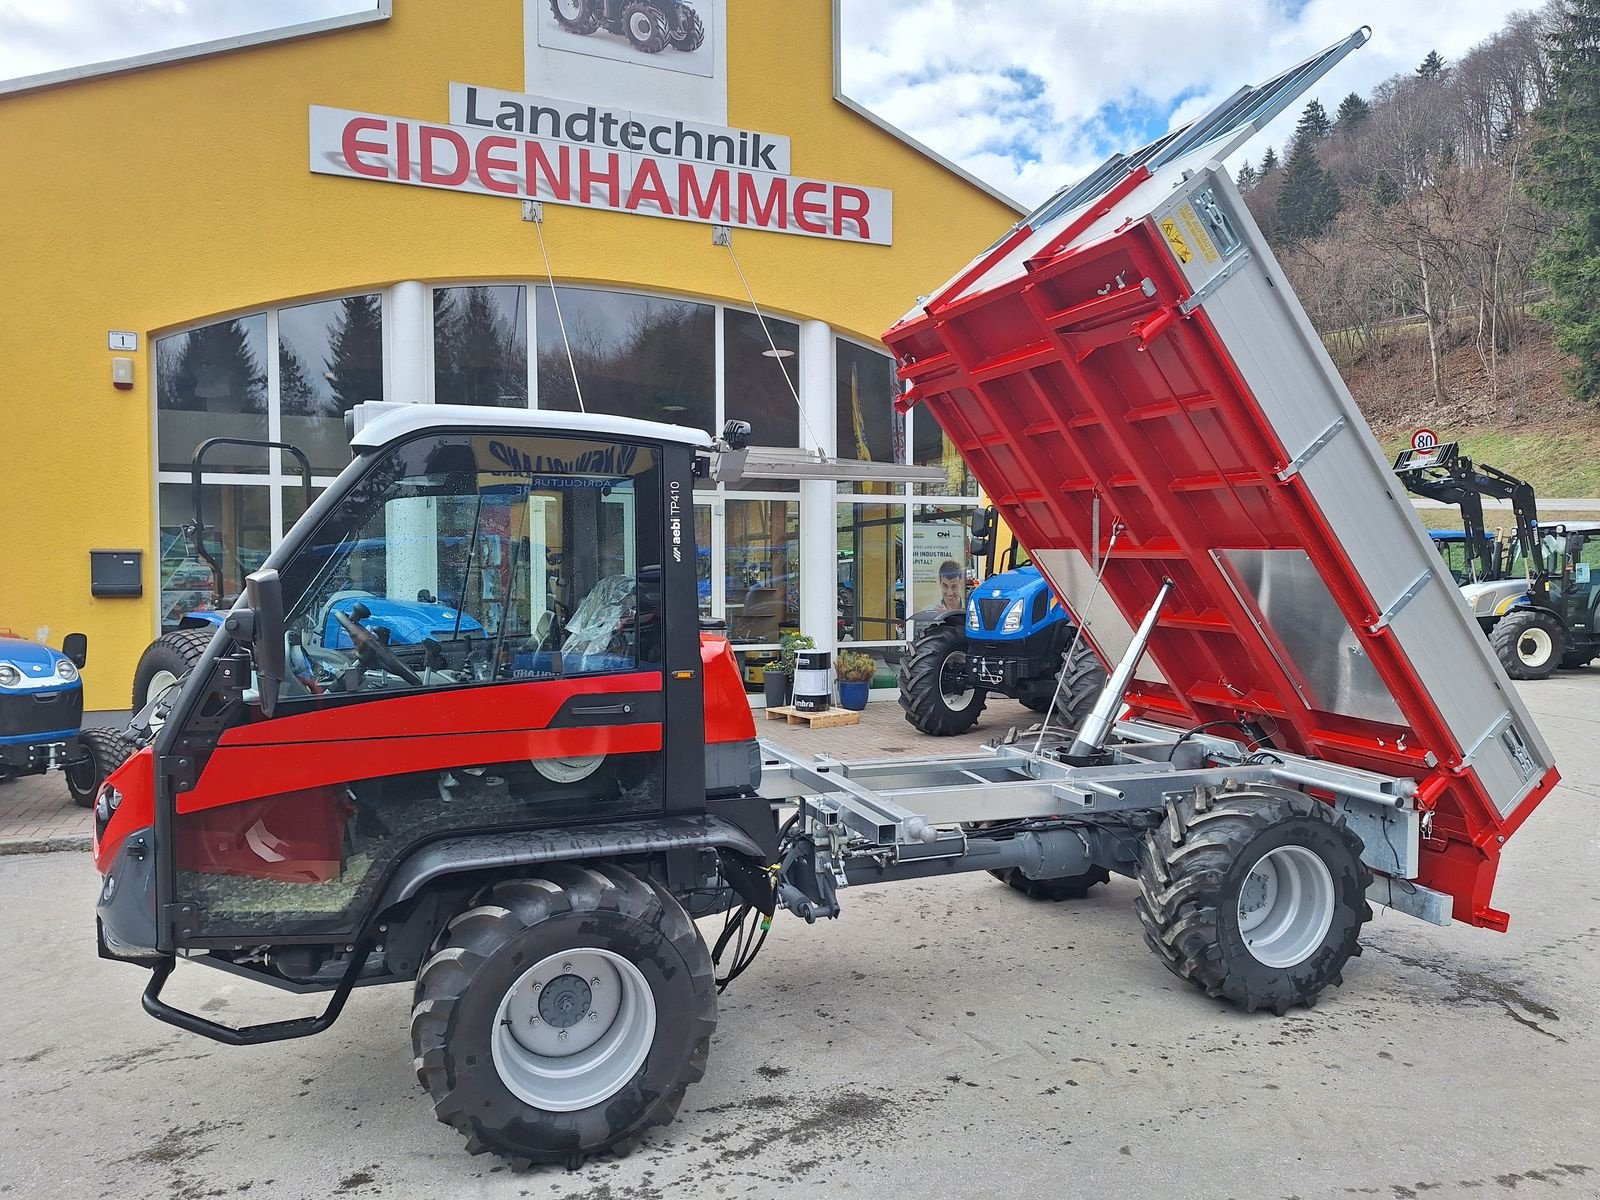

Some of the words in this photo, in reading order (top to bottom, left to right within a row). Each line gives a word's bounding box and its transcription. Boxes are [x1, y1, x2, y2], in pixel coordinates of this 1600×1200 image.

[465, 86, 777, 171] Landtechnik
[341, 116, 871, 240] EIDENHAMMER
[120, 335, 125, 346] 1
[1417, 435, 1433, 448] 80
[670, 481, 680, 516] TP410
[670, 518, 681, 545] aebi
